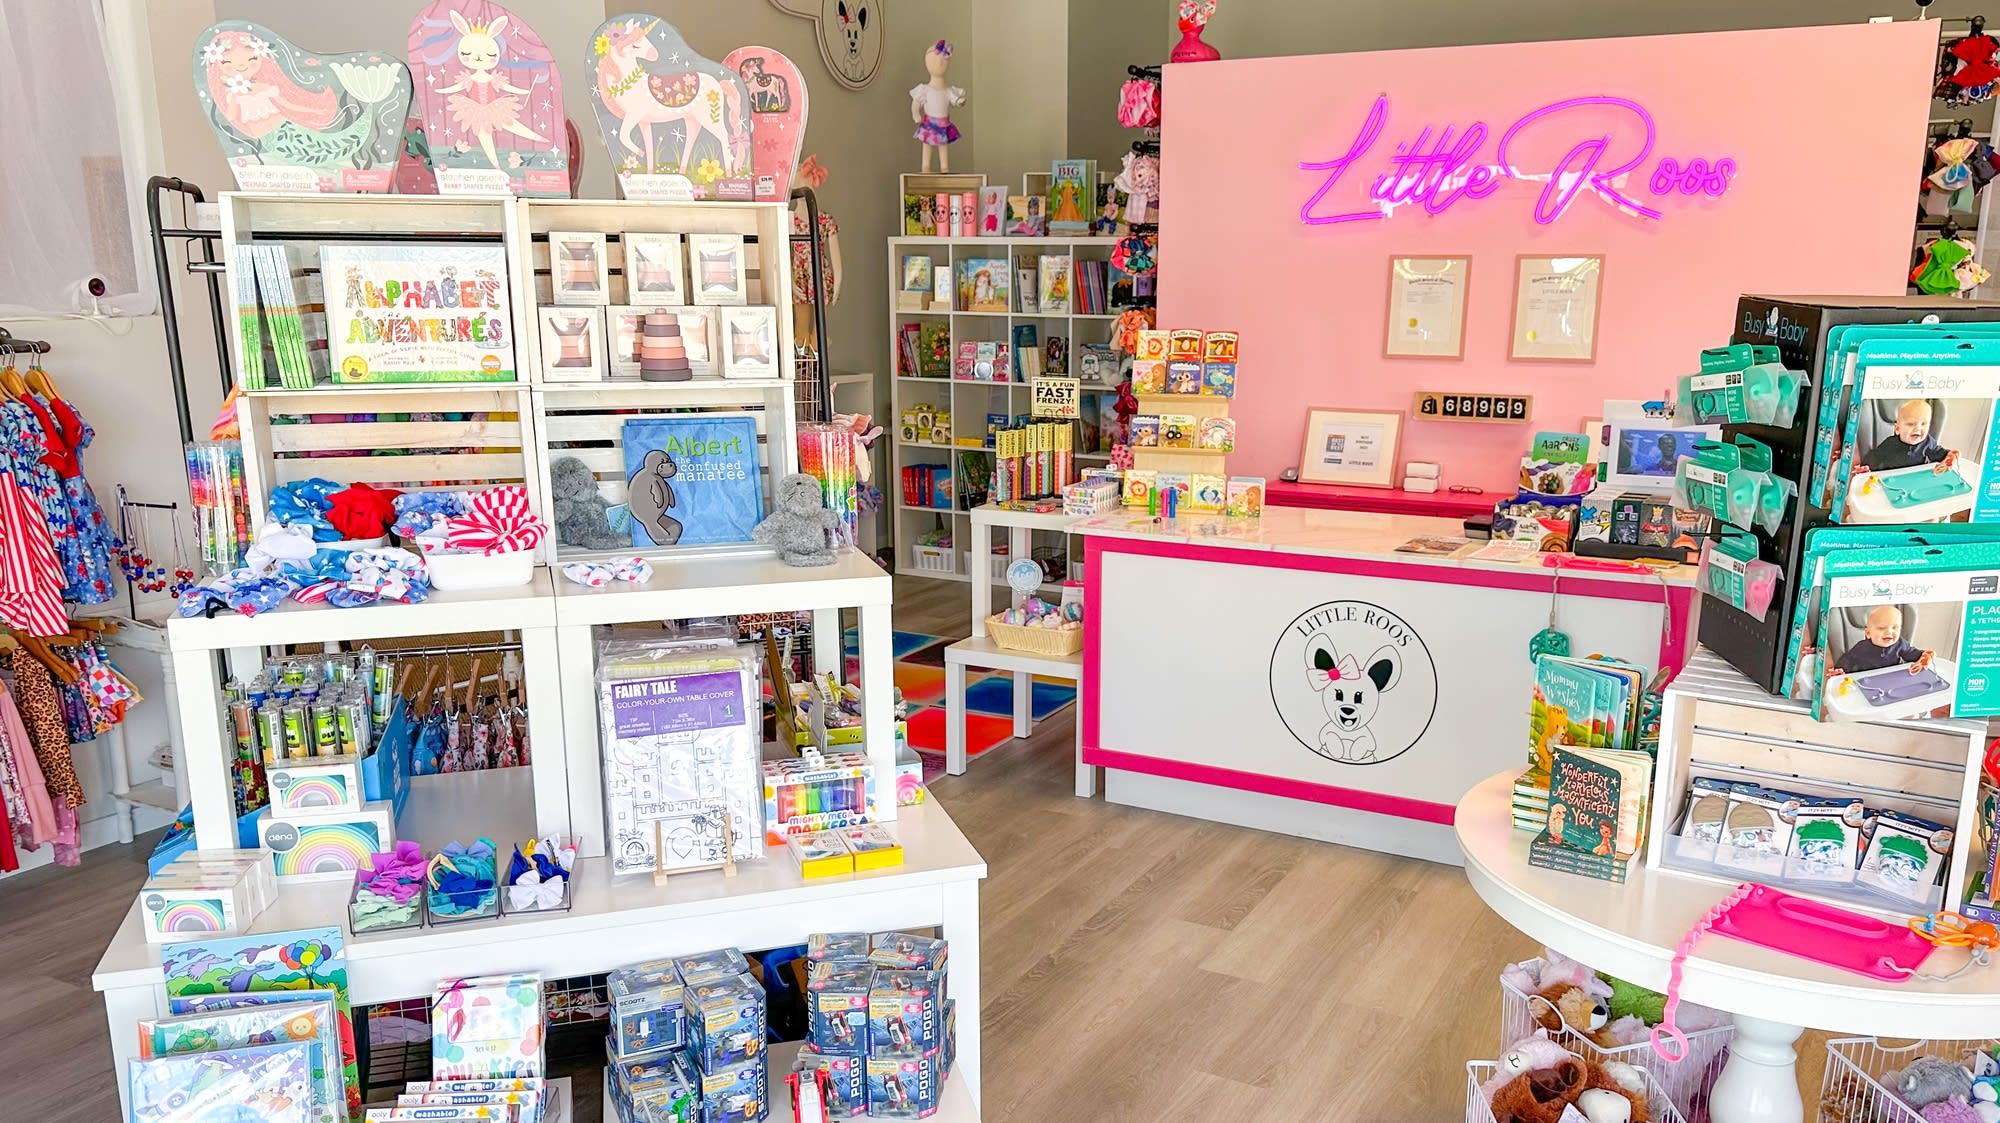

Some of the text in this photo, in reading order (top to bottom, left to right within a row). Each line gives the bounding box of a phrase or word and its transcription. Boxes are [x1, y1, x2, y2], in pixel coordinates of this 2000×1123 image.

[1299, 94, 1736, 225] Little Roos
[1058, 167, 1080, 176] BIG
[345, 278, 500, 309] ALPHABET
[346, 317, 503, 344] ADVENTURES
[1743, 311, 1806, 347] Busy Baby
[1900, 352, 1931, 360] Playtime.
[1932, 352, 1962, 360] Anytime.
[1036, 387, 1075, 398] FAST
[1872, 376, 1962, 392] Busy Baby
[1036, 397, 1075, 405] FRENZY!
[663, 434, 743, 458] Albert
[675, 468, 746, 482] manatee
[680, 461, 743, 472] confused
[1833, 561, 1866, 569] Mealtime.
[1839, 584, 1930, 601] Busy Baby
[1297, 606, 1413, 647] LITTLE ROOS
[615, 680, 678, 699] FAIRY TALE
[1543, 669, 1579, 695] Mommy
[616, 690, 735, 710] COLOR-YOUR-OWN TABLE COVER
[1546, 685, 1580, 712] Wishes
[789, 809, 855, 825] MIGHTY MEGA
[787, 818, 858, 836] MARKERS
[619, 997, 646, 1007] SCOOTZ
[757, 1001, 765, 1051] SCOOTZ
[922, 999, 932, 1041] POGO
[850, 1057, 860, 1098] POGO
[919, 1059, 930, 1100] POGO
[410, 1083, 427, 1091] ooly
[756, 1063, 764, 1112] SCOOTZ
[403, 1095, 487, 1105] ooly ashable!
[371, 1111, 388, 1119] ooly
